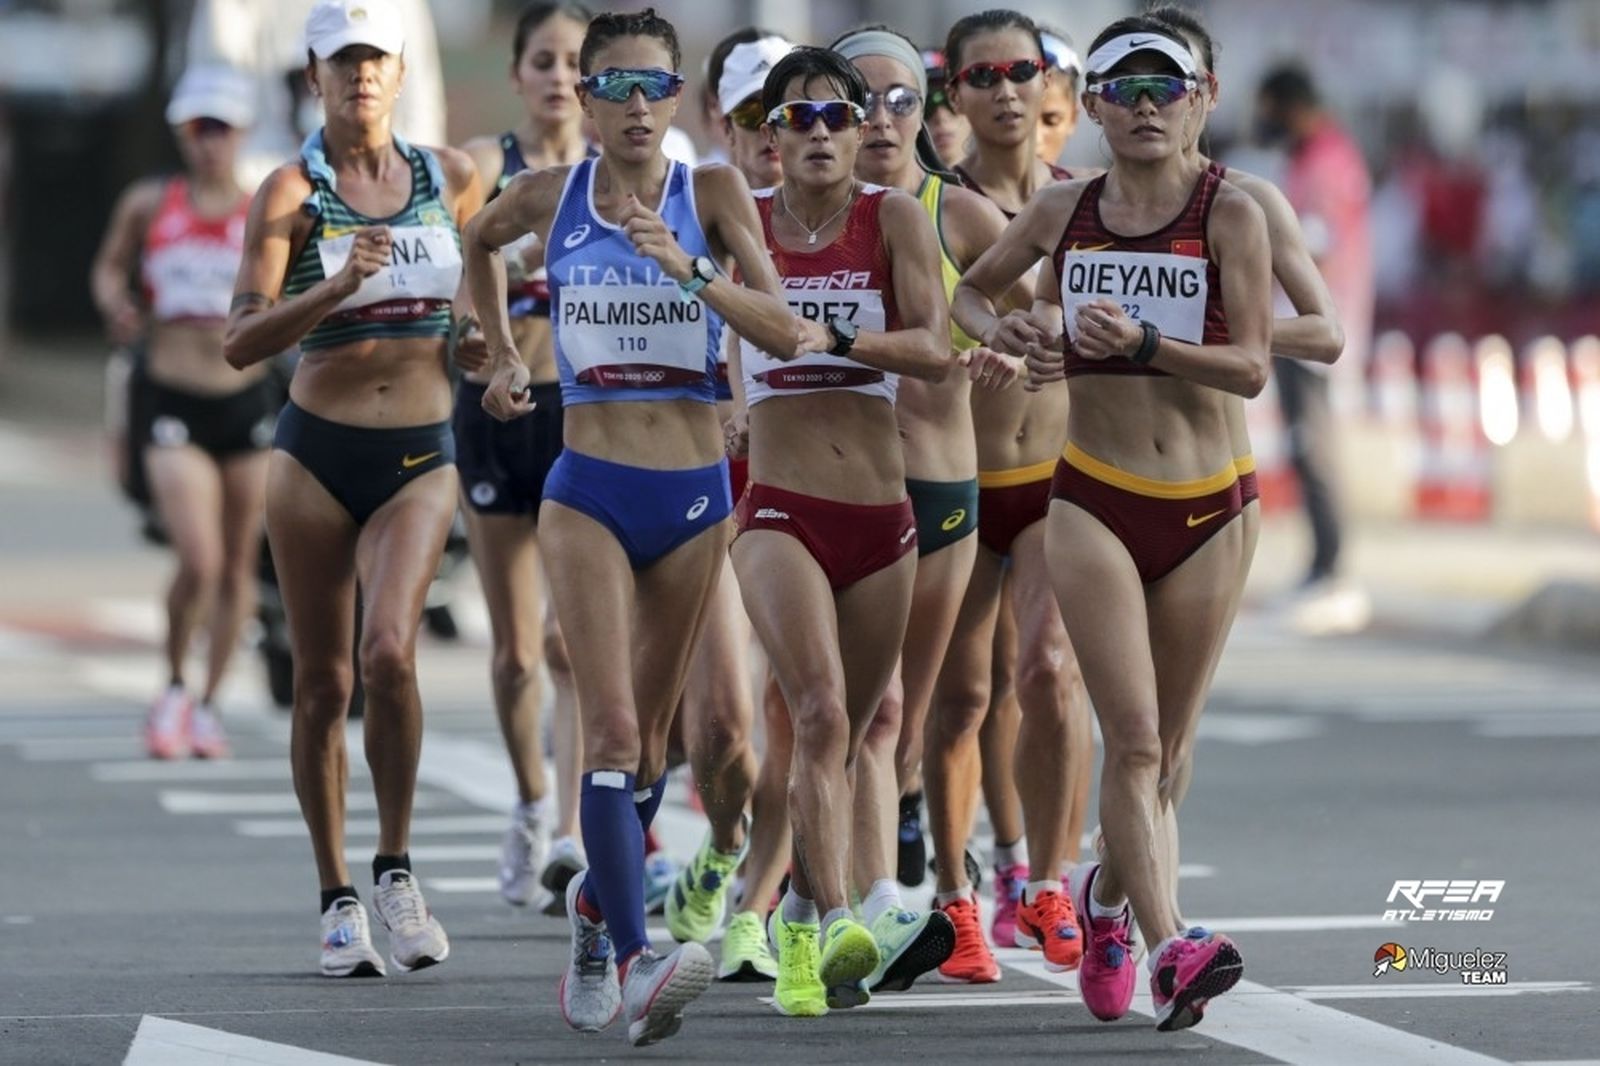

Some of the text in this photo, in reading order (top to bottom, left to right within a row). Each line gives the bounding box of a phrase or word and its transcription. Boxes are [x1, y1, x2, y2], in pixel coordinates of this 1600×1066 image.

[1068, 262, 1200, 299] QIEYANG
[564, 301, 701, 326] PALMISANO
[617, 336, 648, 352] 110
[603, 372, 642, 381] TOKYO 2020
[783, 374, 823, 382] TOKYO 2020
